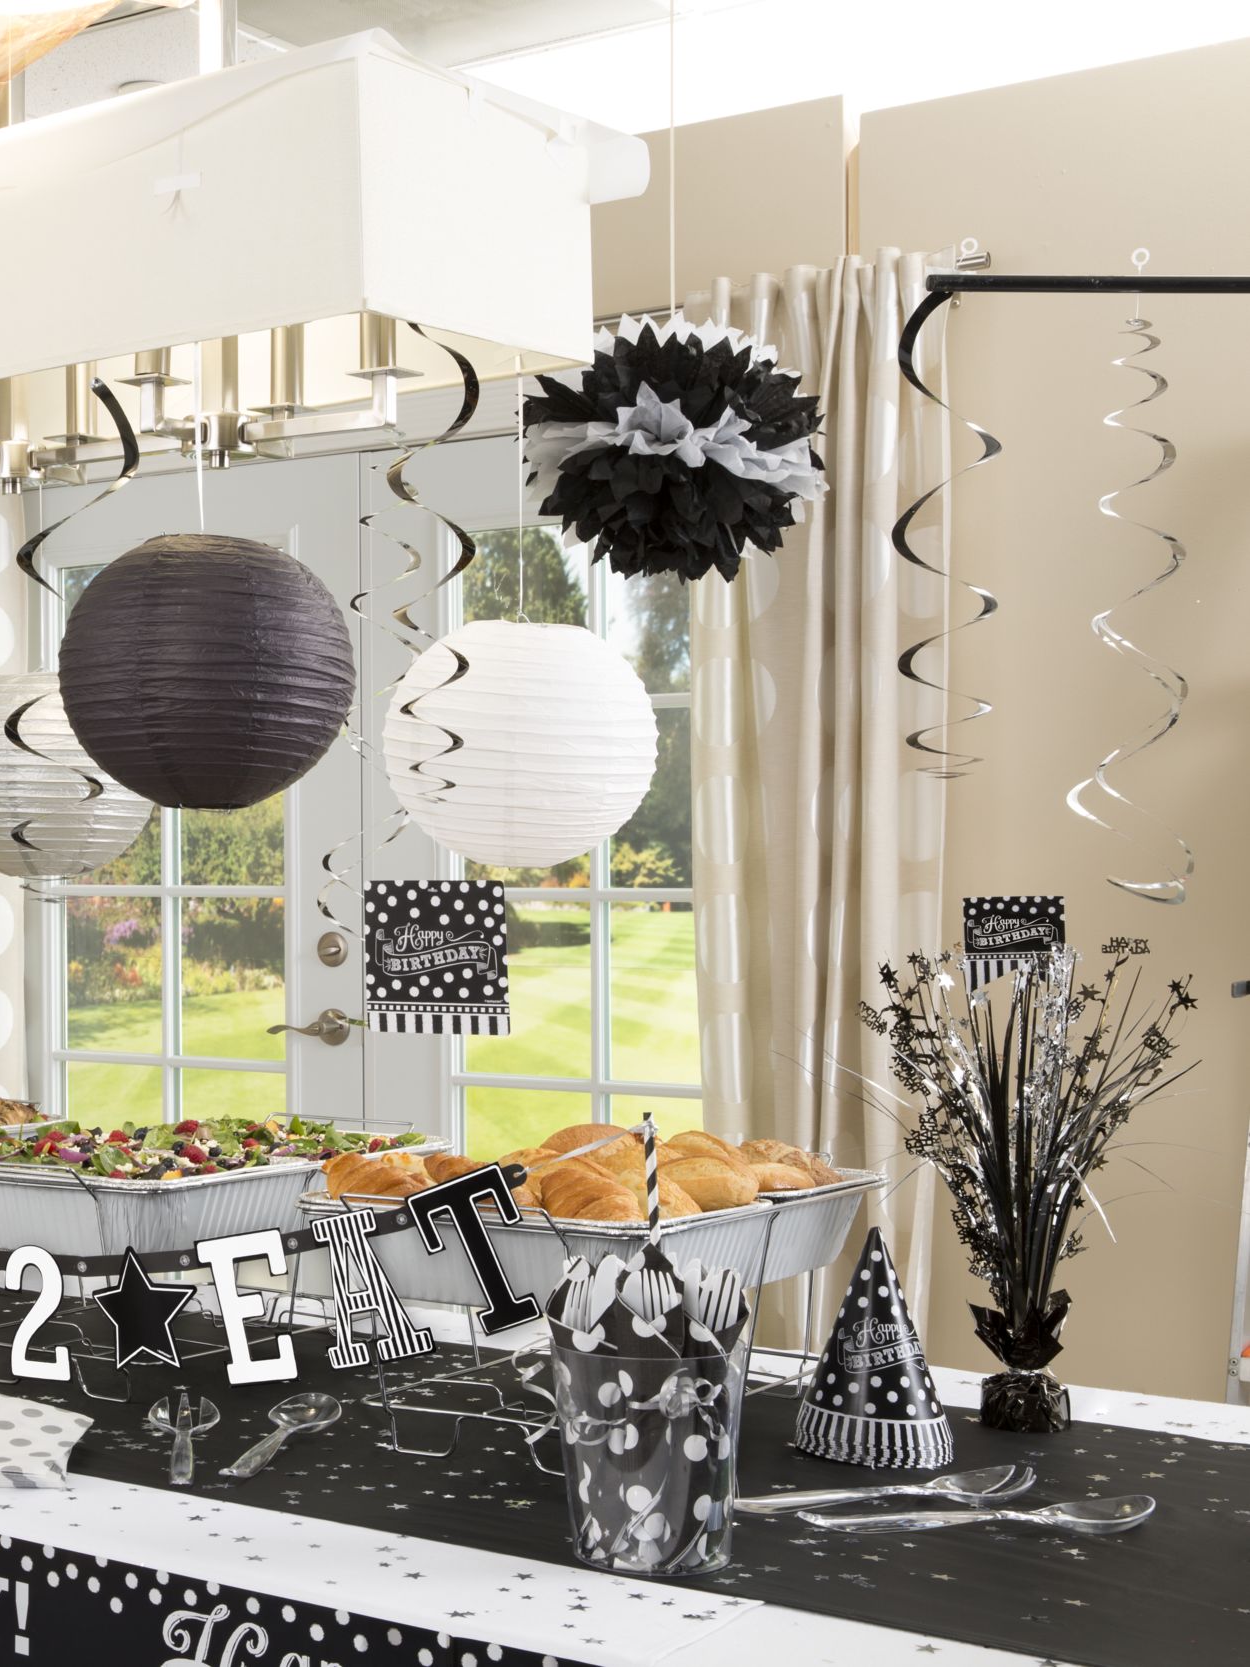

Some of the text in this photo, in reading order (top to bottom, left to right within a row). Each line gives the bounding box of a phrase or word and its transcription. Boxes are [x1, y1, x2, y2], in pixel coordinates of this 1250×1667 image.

[393, 922, 444, 952] Happy
[978, 926, 1048, 947] BIRTHDAY
[981, 914, 1020, 933] Happy
[389, 945, 481, 972] BIRTHDAY
[4, 1243, 73, 1384] 2
[195, 1162, 547, 1386] EAT
[852, 1316, 907, 1348] Happy
[851, 1341, 923, 1369] BIRTHDA
